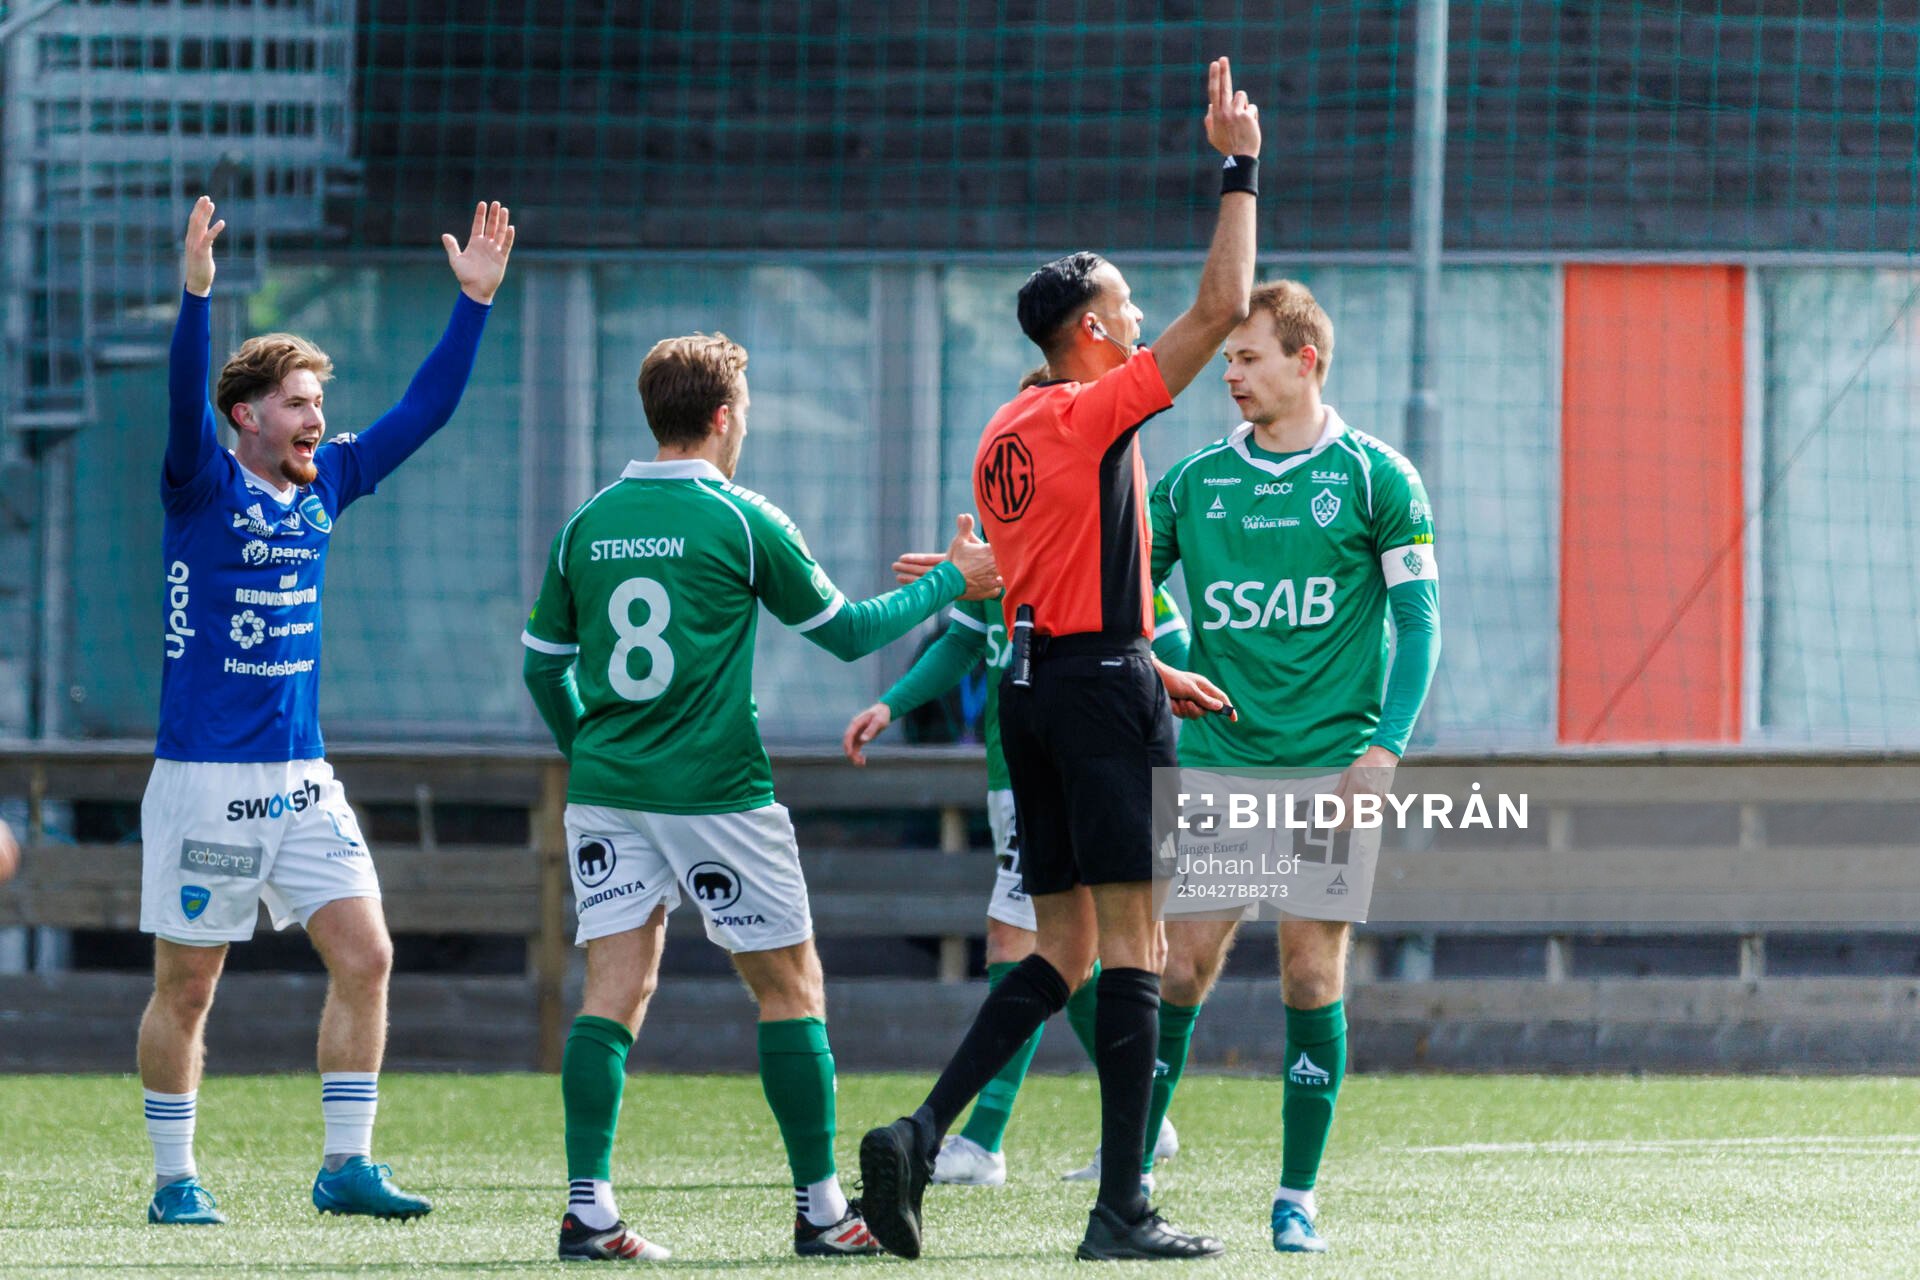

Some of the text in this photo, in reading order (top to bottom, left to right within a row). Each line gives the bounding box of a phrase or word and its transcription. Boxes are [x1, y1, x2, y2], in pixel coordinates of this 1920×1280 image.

[984, 440, 1028, 514] MG
[1206, 511, 1226, 519] SELECT
[590, 537, 685, 561] STENSSON
[165, 560, 196, 659] upab
[1203, 576, 1336, 630] SSAB
[608, 577, 675, 701] 8
[187, 847, 254, 869] colorama
